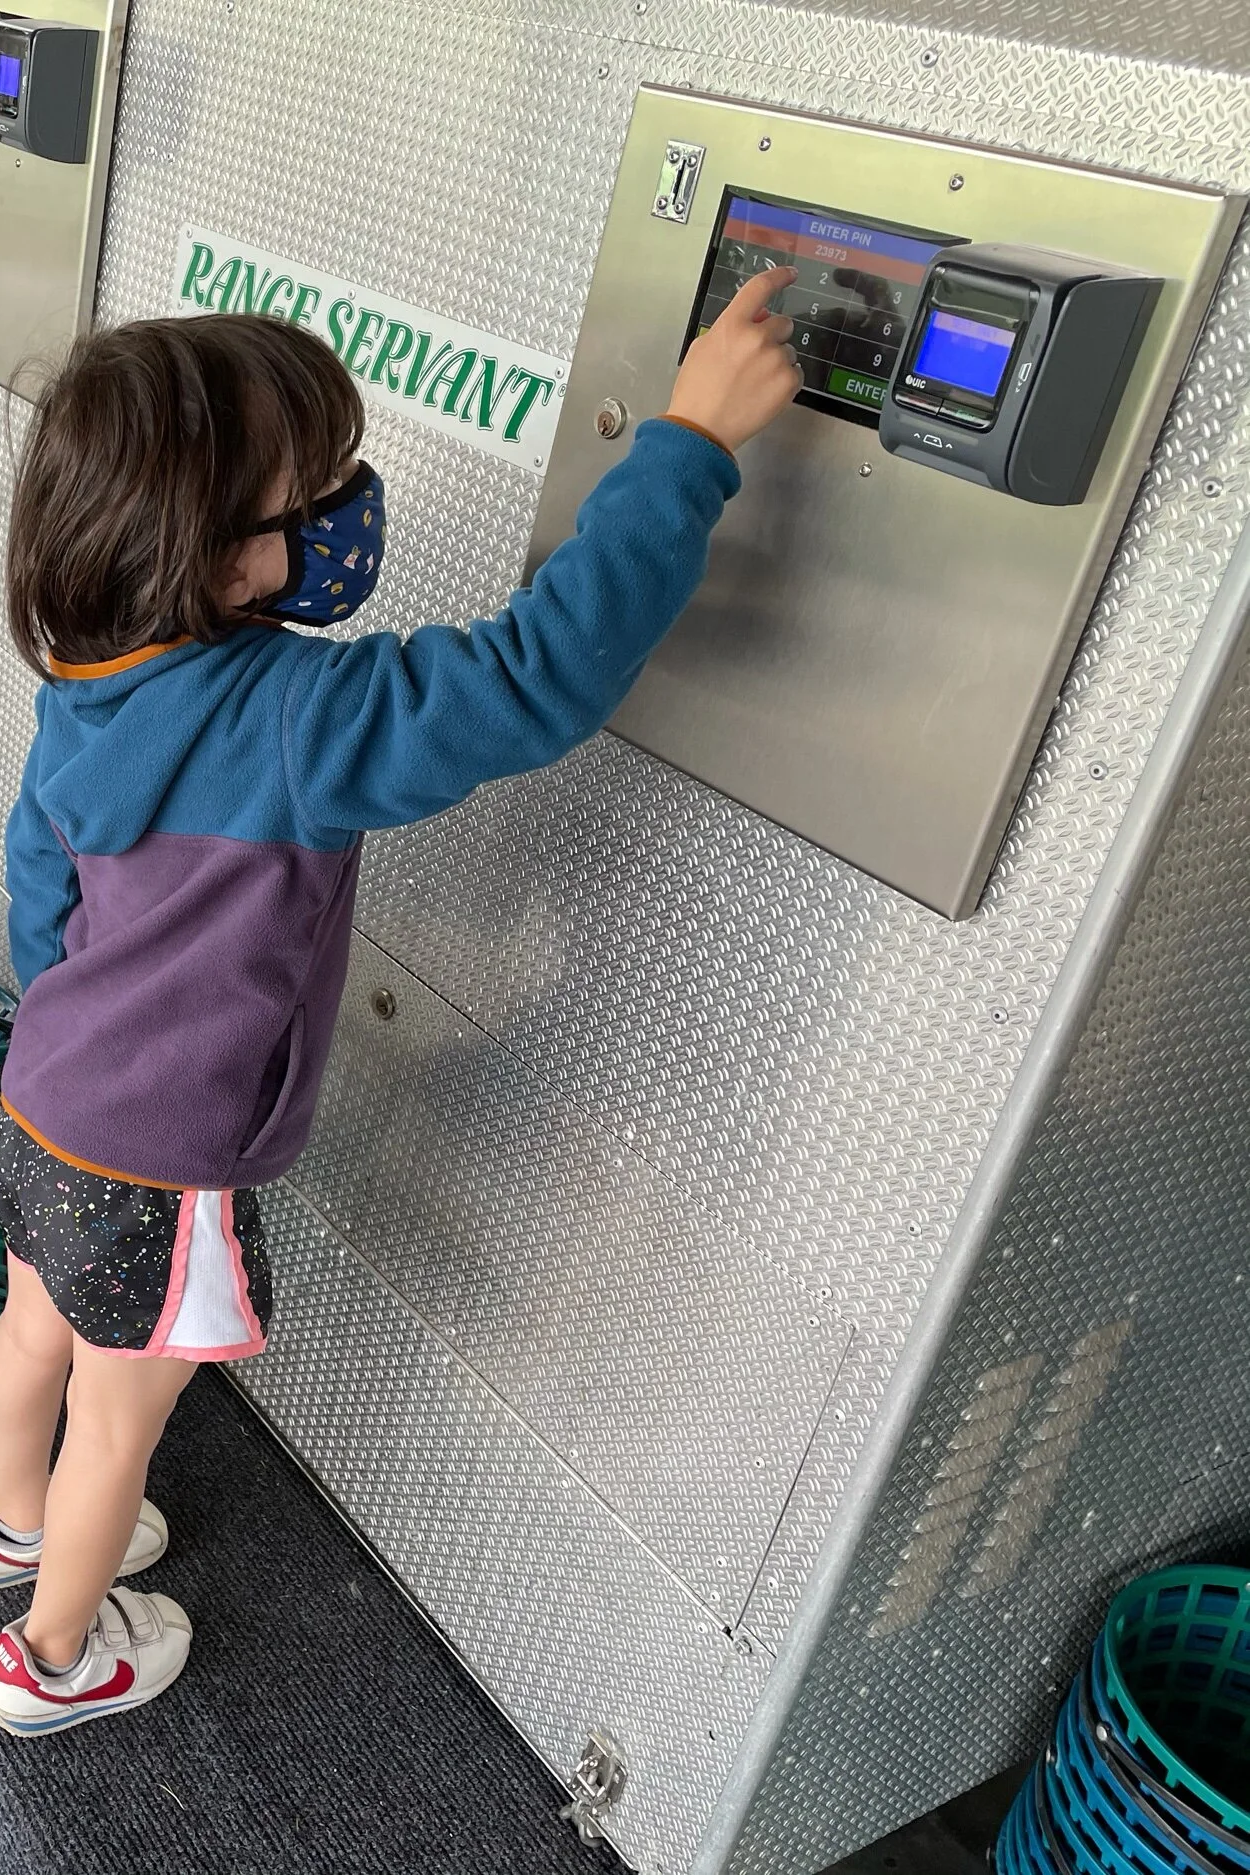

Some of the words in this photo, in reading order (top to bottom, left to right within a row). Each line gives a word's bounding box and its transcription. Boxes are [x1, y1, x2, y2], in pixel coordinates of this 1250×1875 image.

[810, 221, 849, 241] ENTER
[851, 231, 872, 246] PIN
[752, 254, 758, 267] 1
[819, 272, 829, 285] 2
[893, 291, 902, 305] 3
[810, 302, 819, 315] 5
[883, 323, 892, 336] 6
[180, 242, 323, 326] RANGE
[326, 297, 555, 443] SERVANT
[801, 332, 810, 345] 8
[873, 353, 882, 367] 9
